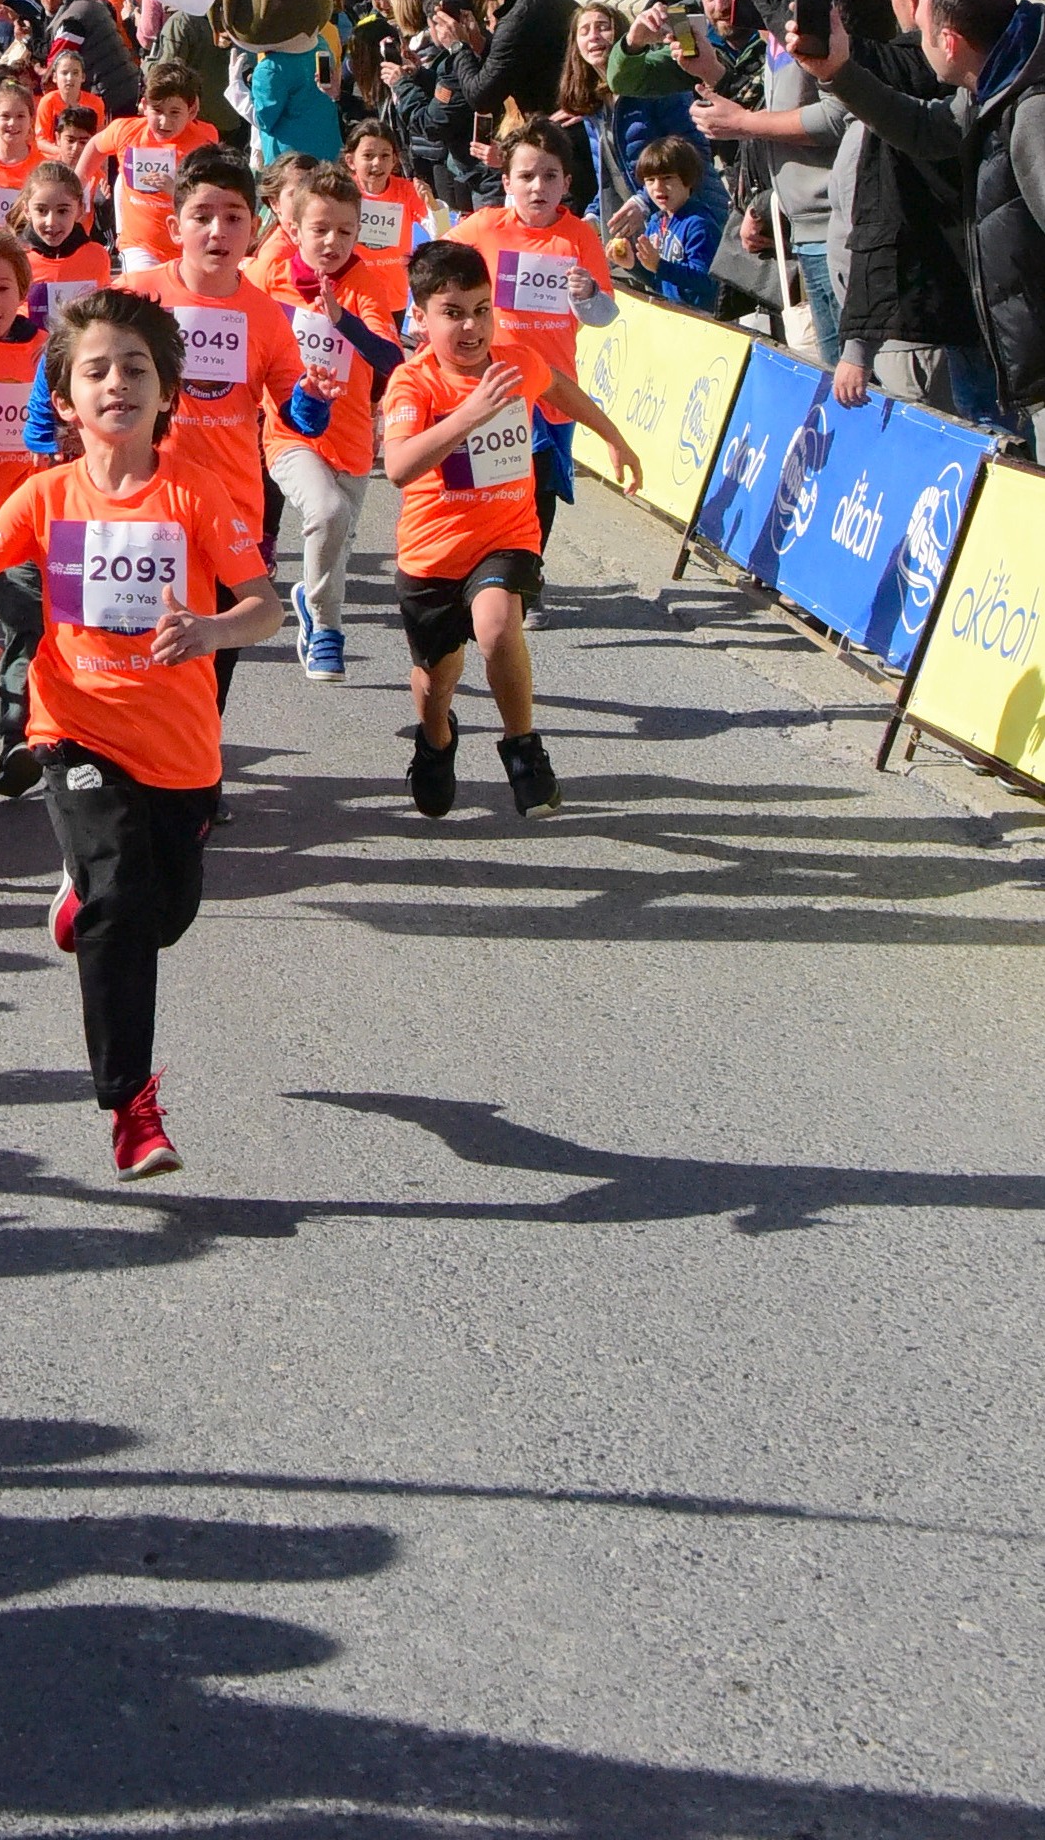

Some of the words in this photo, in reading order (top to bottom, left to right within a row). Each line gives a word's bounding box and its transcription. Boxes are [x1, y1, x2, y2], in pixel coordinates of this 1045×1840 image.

[135, 161, 170, 173] 2074
[360, 213, 396, 228] 2014
[519, 271, 568, 290] 2062
[178, 329, 239, 351] 2049
[296, 330, 344, 355] 2091
[471, 425, 528, 456] 2080
[831, 478, 884, 562] akbatı
[88, 555, 176, 583] 2093
[114, 592, 134, 604] 7-9
[137, 591, 157, 606] Yaş
[951, 568, 1040, 666] akbatı
